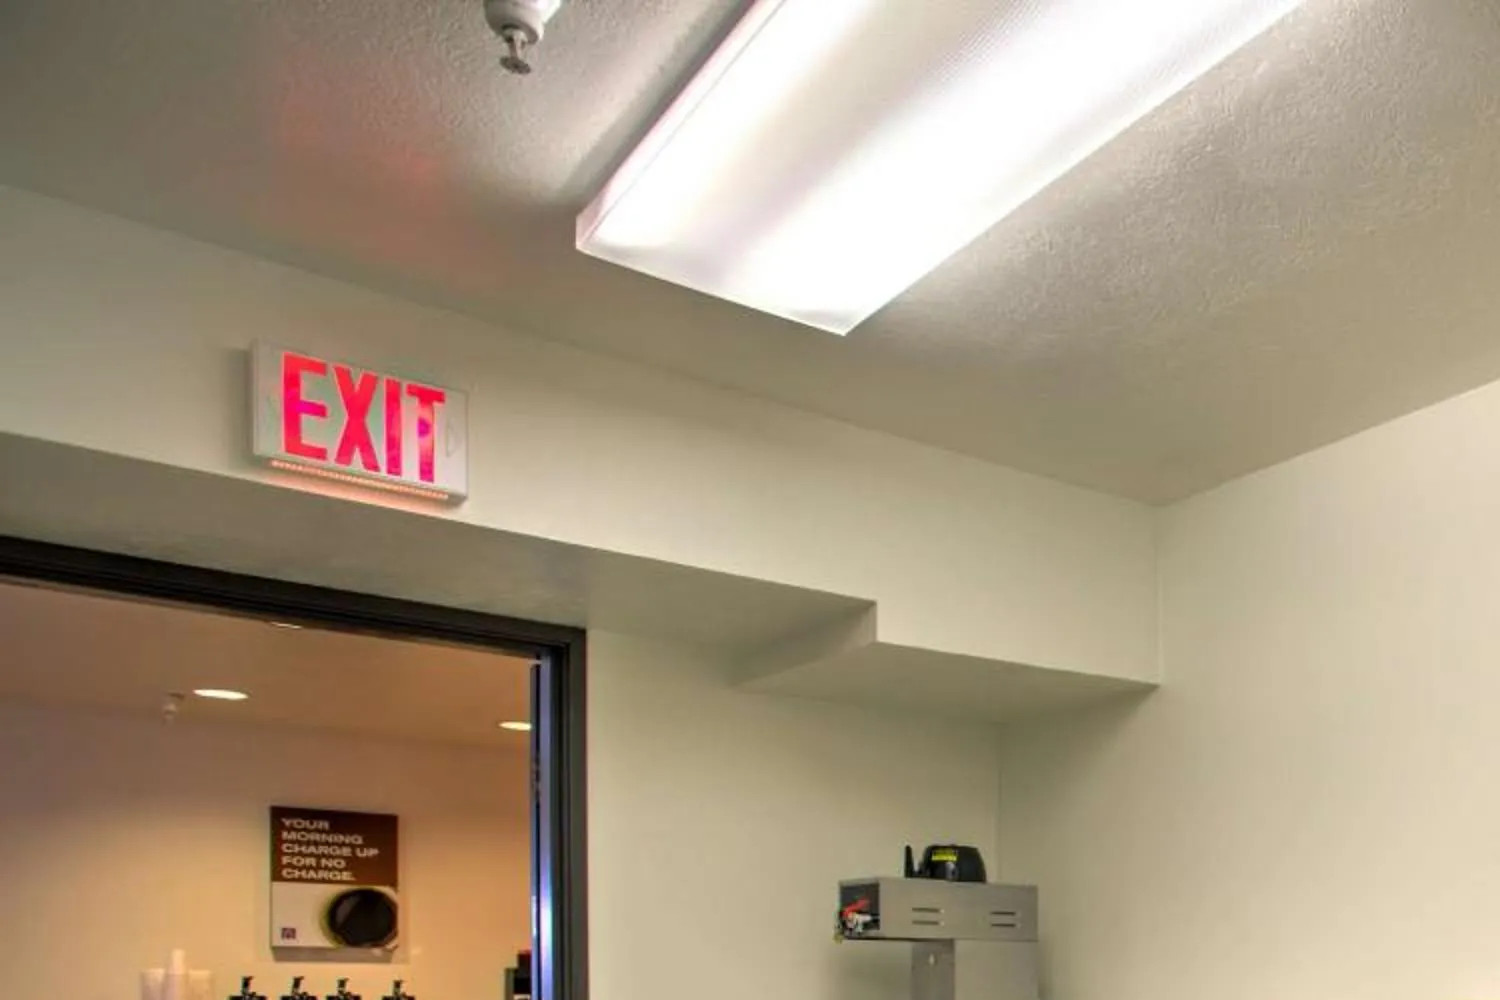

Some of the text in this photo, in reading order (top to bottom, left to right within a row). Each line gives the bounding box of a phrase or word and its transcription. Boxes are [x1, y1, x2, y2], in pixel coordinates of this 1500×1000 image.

[281, 351, 446, 484] EXIT
[281, 818, 330, 830] YOUR
[281, 831, 364, 845] MORNING
[281, 843, 380, 858] CHARGE UP
[281, 856, 347, 869] FOR NO
[281, 868, 356, 881] CHARGE.
